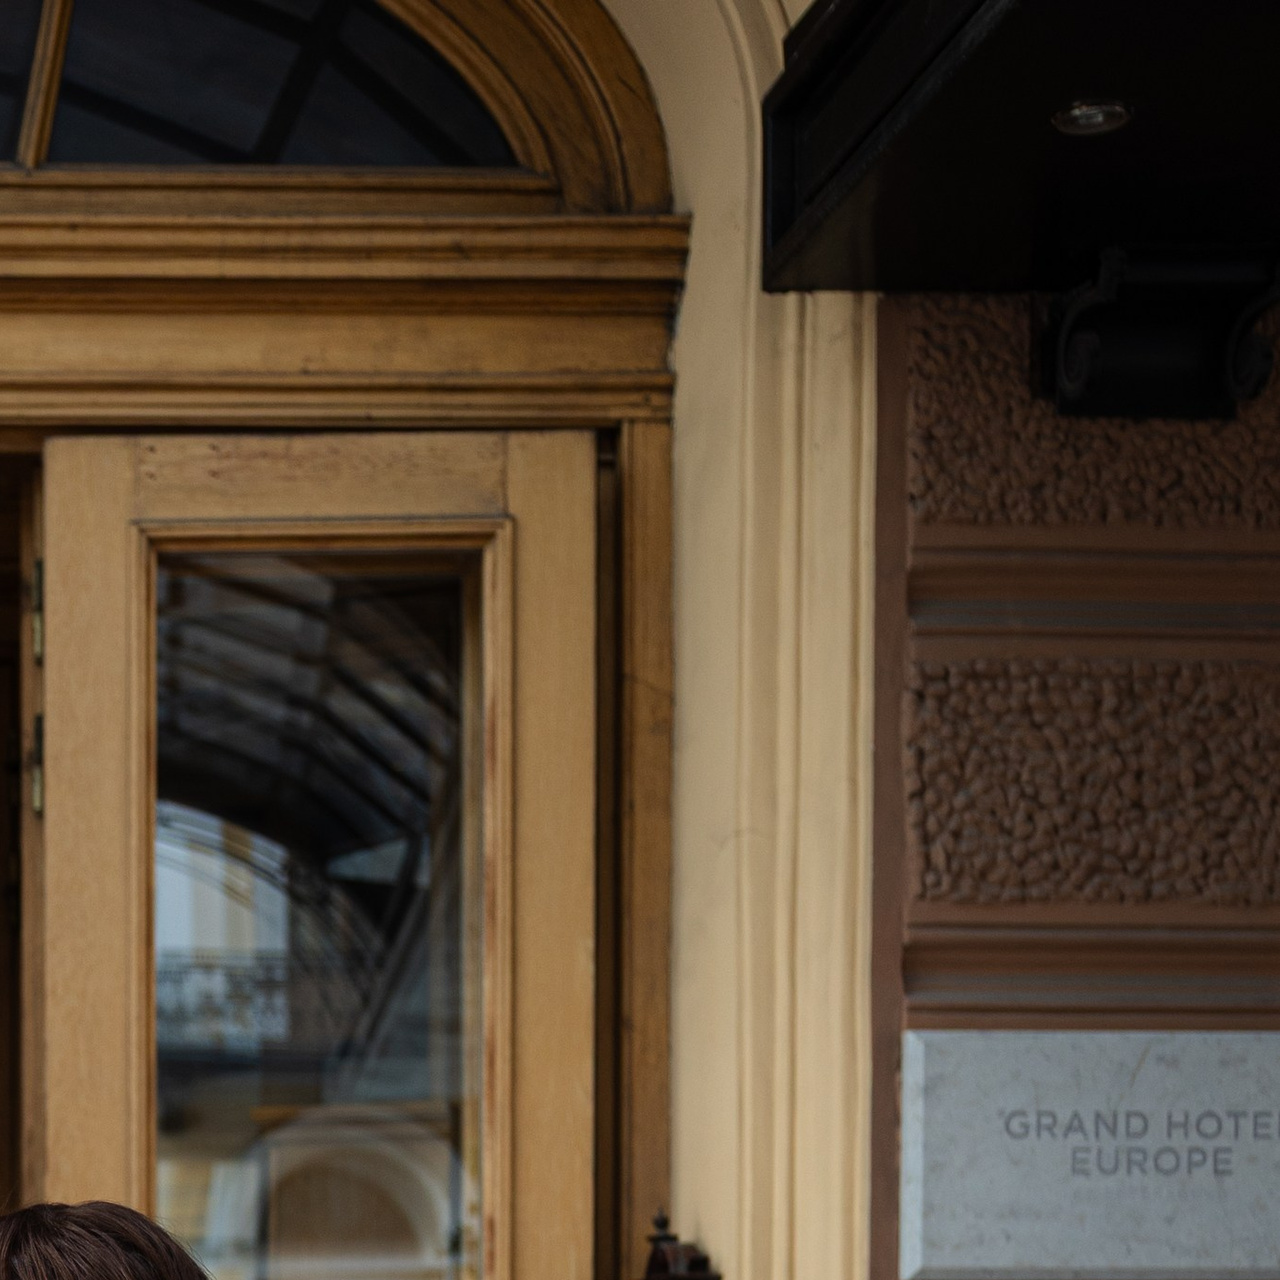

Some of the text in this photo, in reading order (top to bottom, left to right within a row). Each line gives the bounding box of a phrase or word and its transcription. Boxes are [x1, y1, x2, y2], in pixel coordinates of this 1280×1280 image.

[1003, 1109, 1280, 1141] GRAND HOTE
[1071, 1146, 1234, 1177] EUROPE
